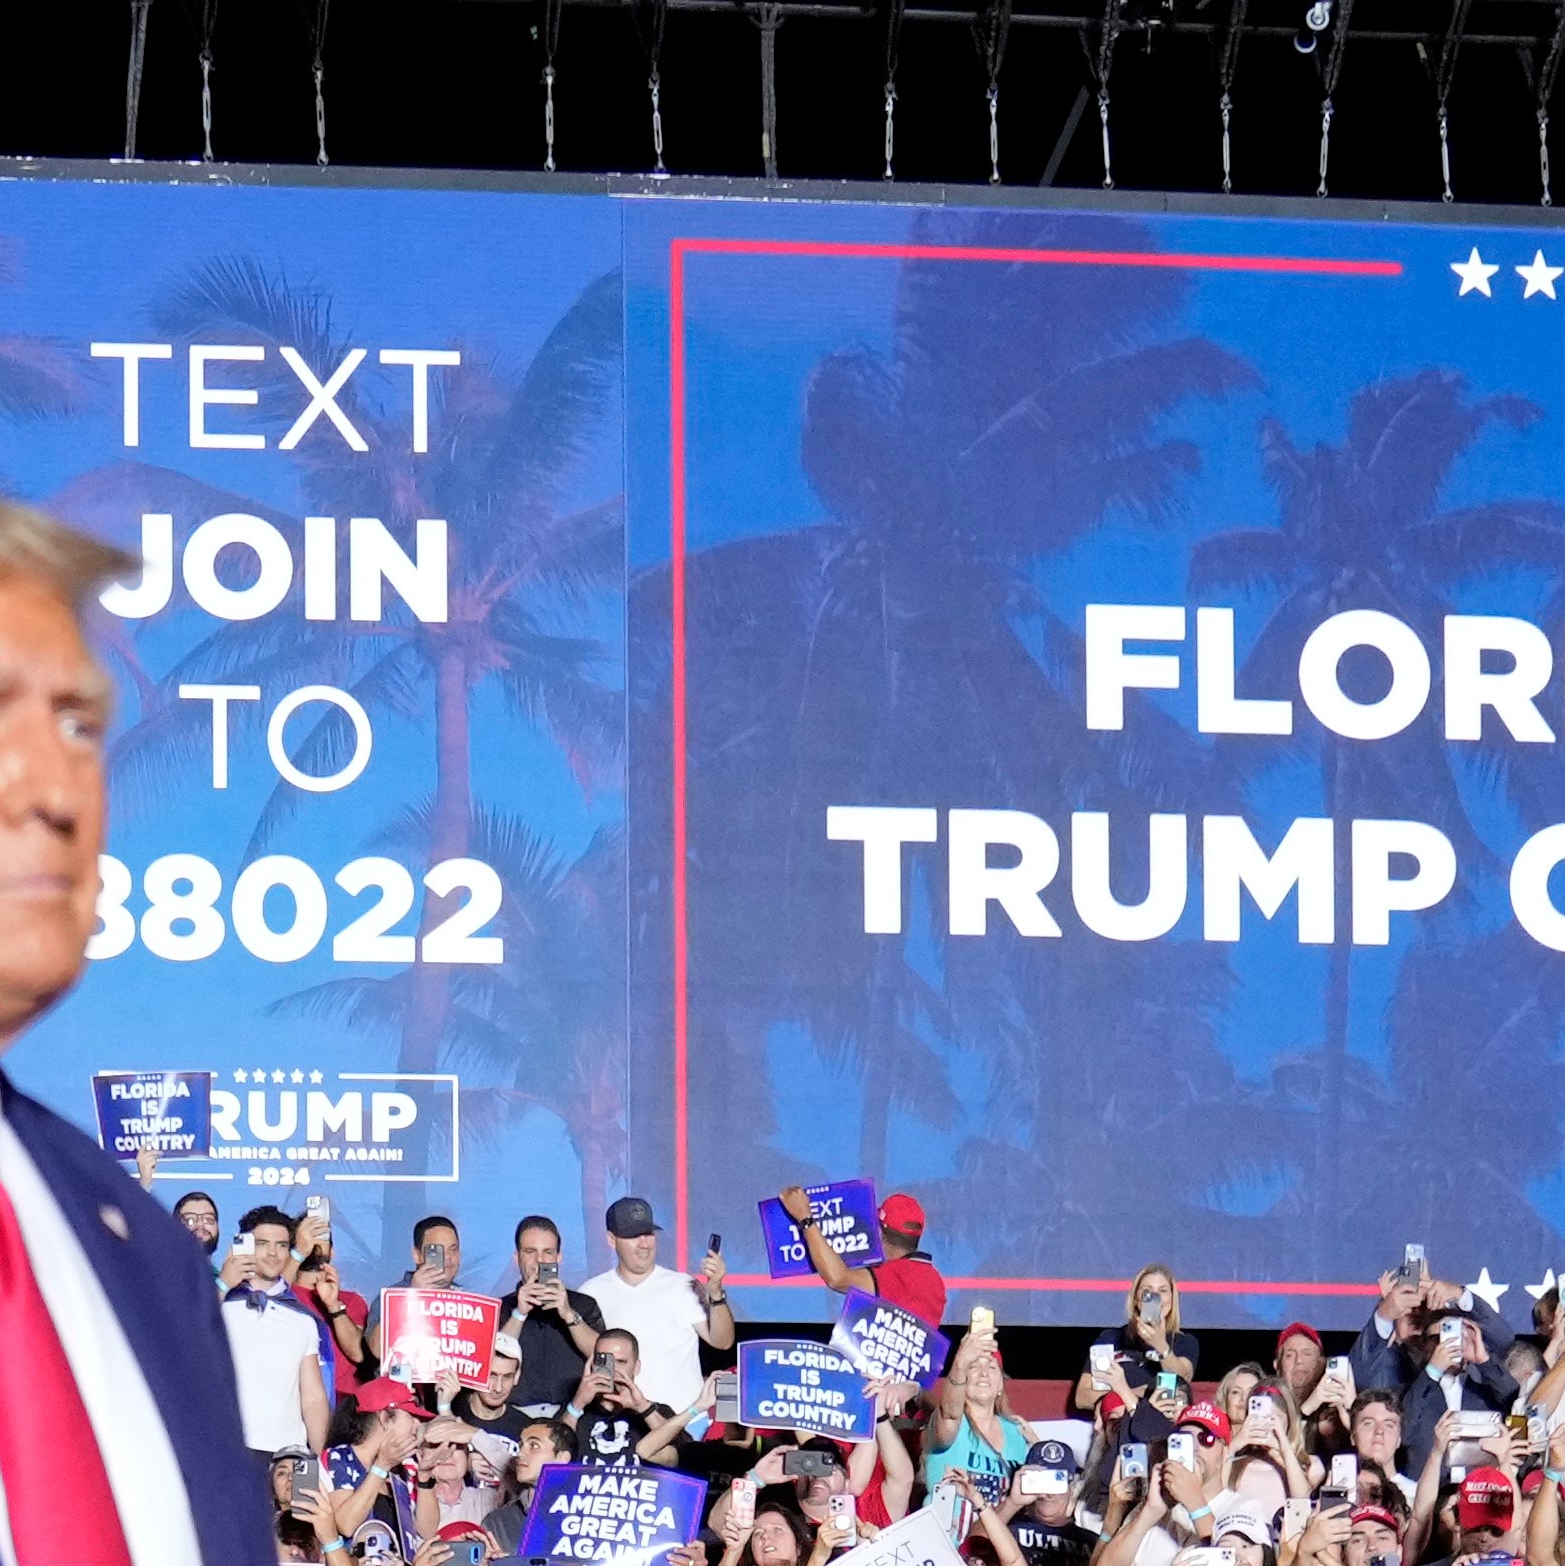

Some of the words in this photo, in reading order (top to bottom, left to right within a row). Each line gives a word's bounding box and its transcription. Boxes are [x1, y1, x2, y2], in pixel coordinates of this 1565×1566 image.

[90, 343, 461, 453] TEXT
[98, 513, 448, 623] JOIN
[178, 684, 372, 792] TO
[826, 806, 1457, 945] TRUMP
[110, 1080, 192, 1101] FLORIDA
[140, 1100, 159, 1117] IS
[210, 1090, 418, 1144] RUMP
[120, 1118, 184, 1135] TRUMP
[114, 1134, 196, 1153] COUNTRY
[209, 1146, 282, 1161] AMERICA
[286, 1148, 340, 1162] GREAT
[345, 1149, 404, 1162] AGAIN!
[247, 1167, 311, 1186] 2024
[810, 1197, 843, 1219] EXT
[789, 1215, 855, 1242] TUMP
[779, 1244, 806, 1263] TO
[827, 1233, 870, 1254] 022
[407, 1299, 485, 1323] FLORIDA
[440, 1319, 459, 1336] IS
[874, 1307, 927, 1346] MAKE
[428, 1335, 477, 1358] RUMP
[851, 1318, 932, 1373] AMERICA
[764, 1349, 856, 1375] FLORIDA
[859, 1339, 922, 1380] GREAT
[800, 1369, 821, 1385] IS
[773, 1383, 846, 1407] TRUMP
[758, 1400, 858, 1431] COUNTRY
[577, 1474, 660, 1502] MAKE
[548, 1494, 677, 1530] AMERICA
[560, 1515, 658, 1548] GREAT
